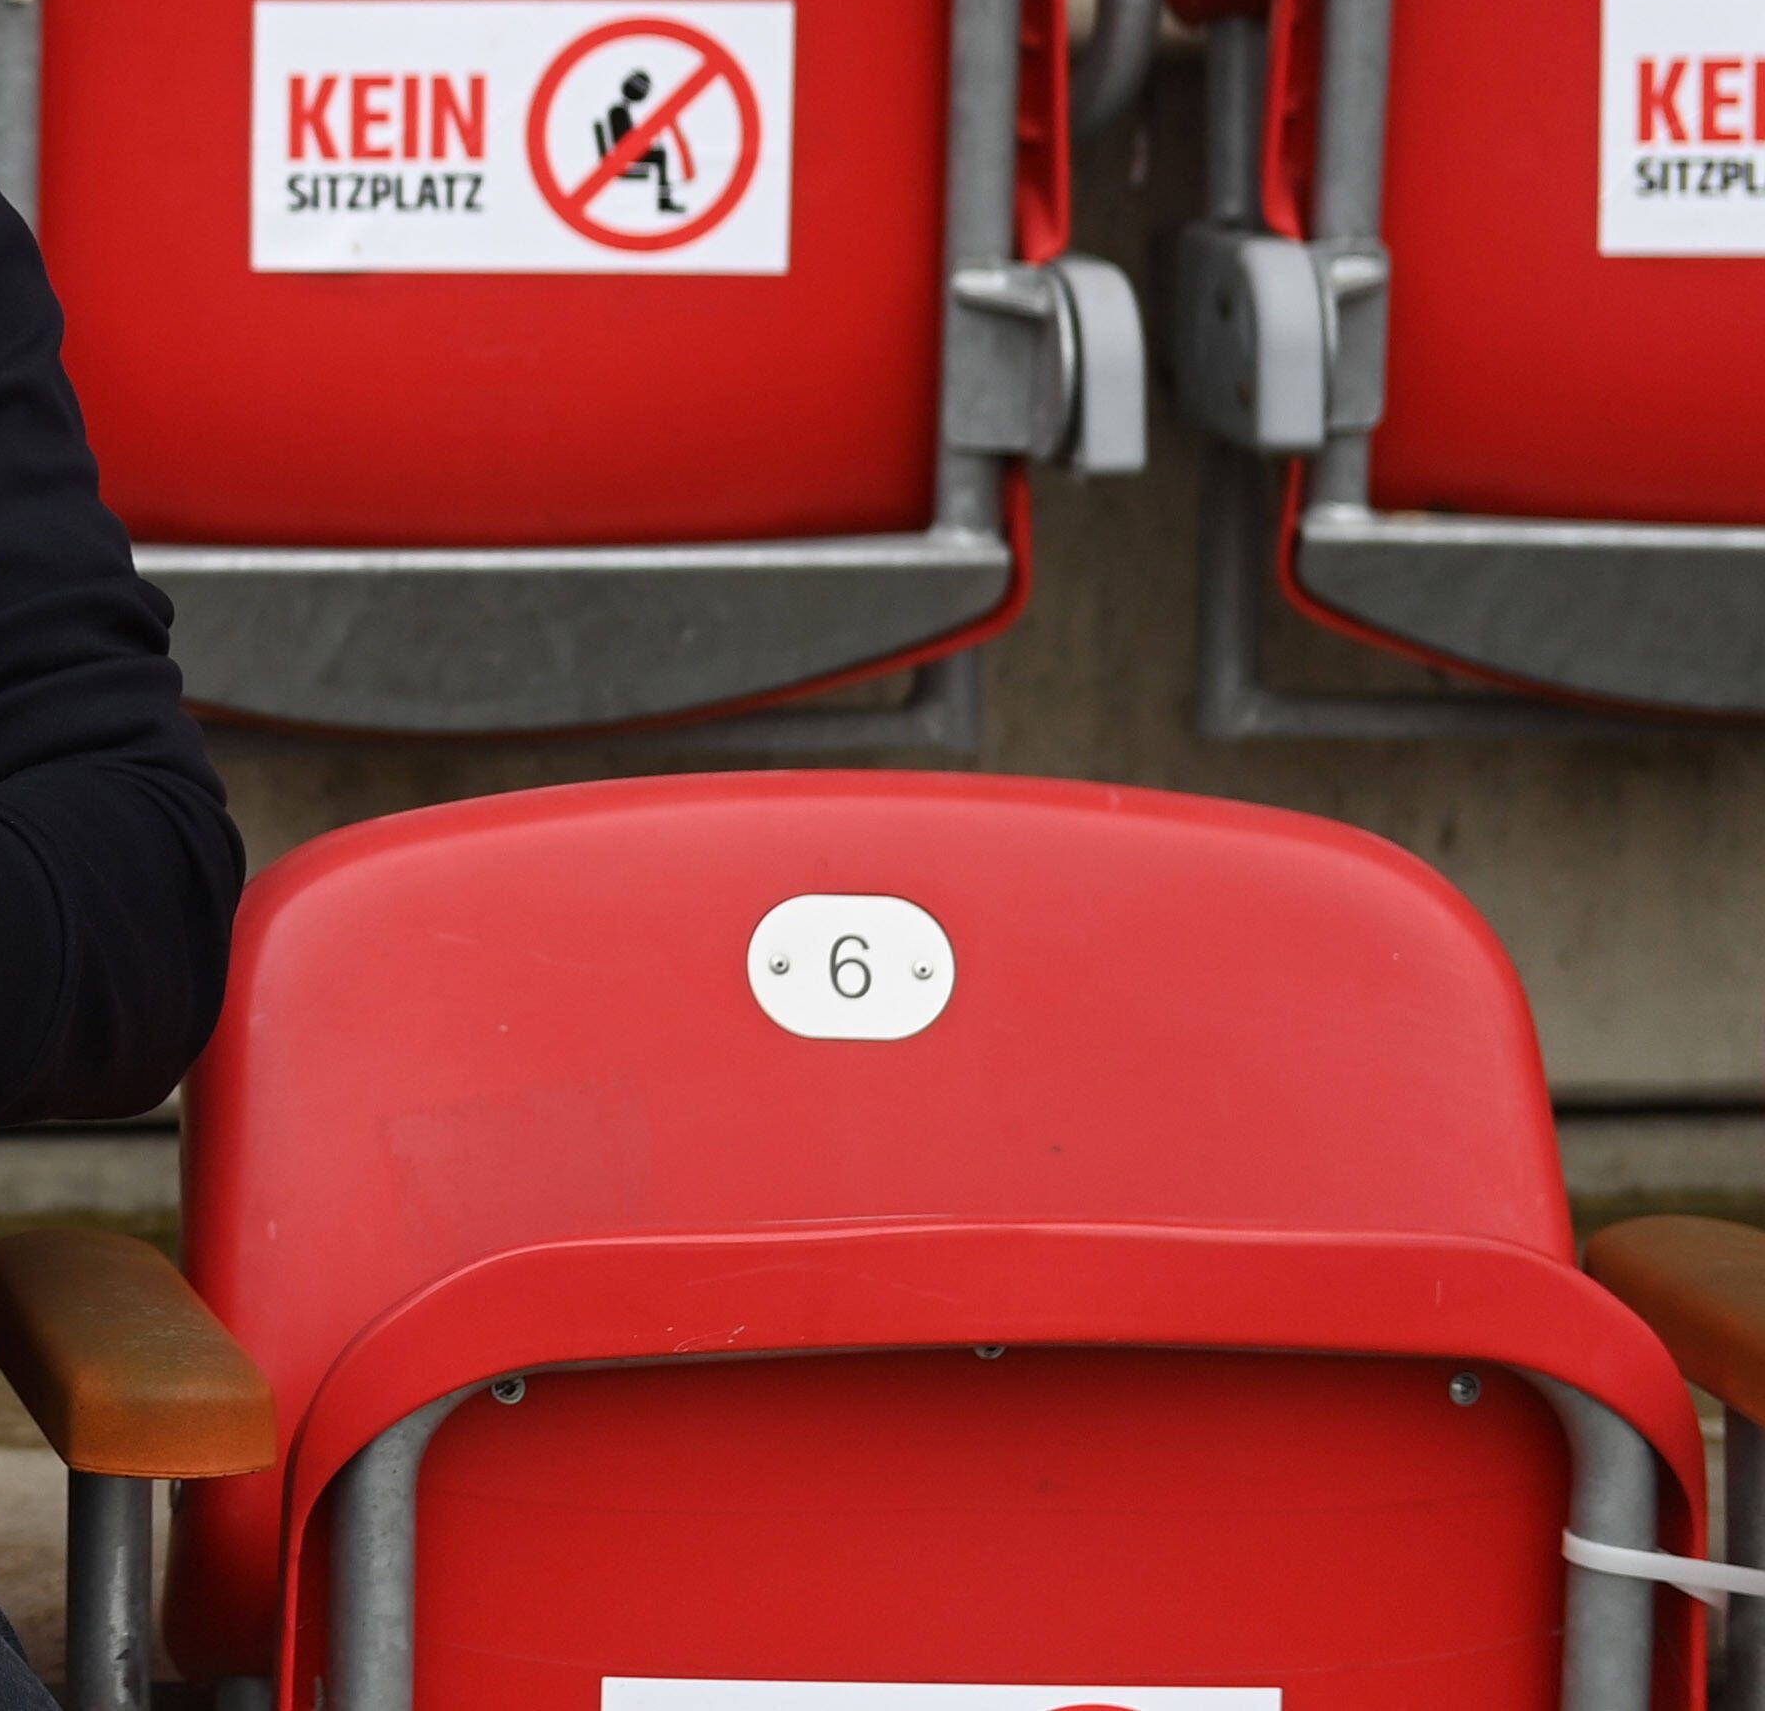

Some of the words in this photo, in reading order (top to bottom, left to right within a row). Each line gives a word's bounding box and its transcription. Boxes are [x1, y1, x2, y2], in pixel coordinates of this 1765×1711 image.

[287, 73, 486, 160] KEIN
[286, 173, 483, 211] SITZPLATZ
[1636, 158, 1765, 195] SITZPL
[829, 934, 872, 999] 6
